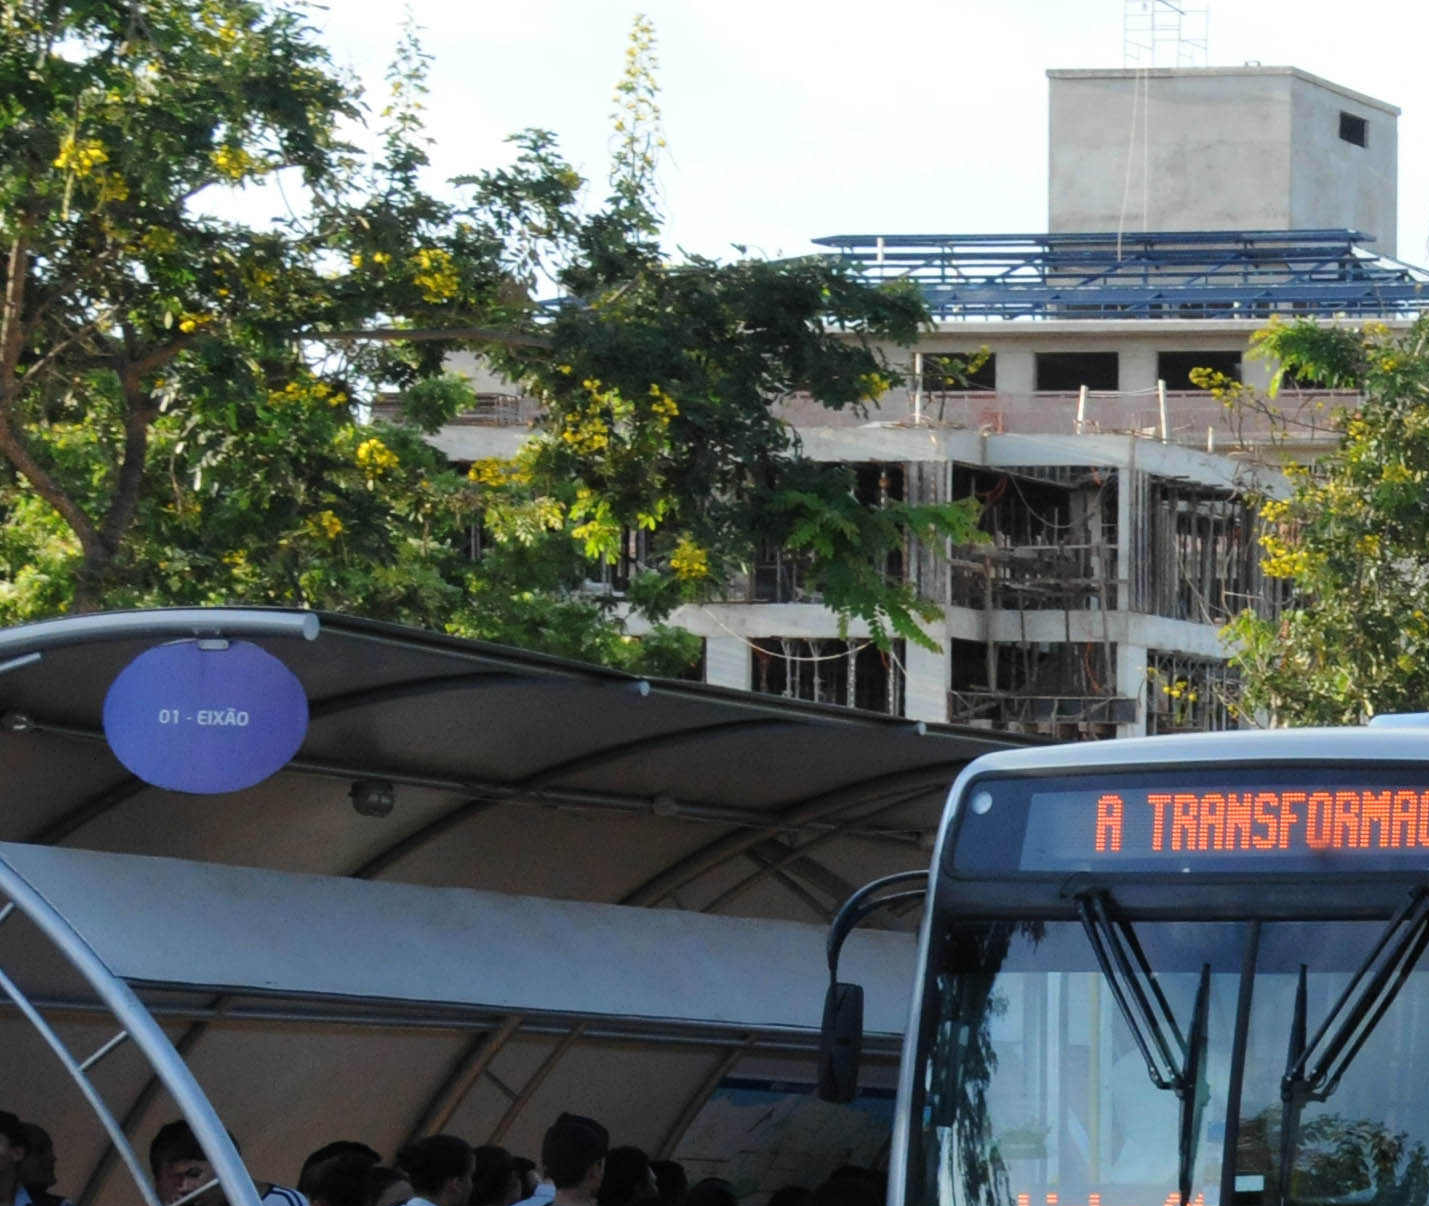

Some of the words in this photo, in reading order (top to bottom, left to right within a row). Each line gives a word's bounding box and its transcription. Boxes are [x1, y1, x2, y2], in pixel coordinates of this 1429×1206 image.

[159, 709, 179, 724] 01
[197, 707, 249, 726] EIXÃO
[1096, 794, 1123, 851] A
